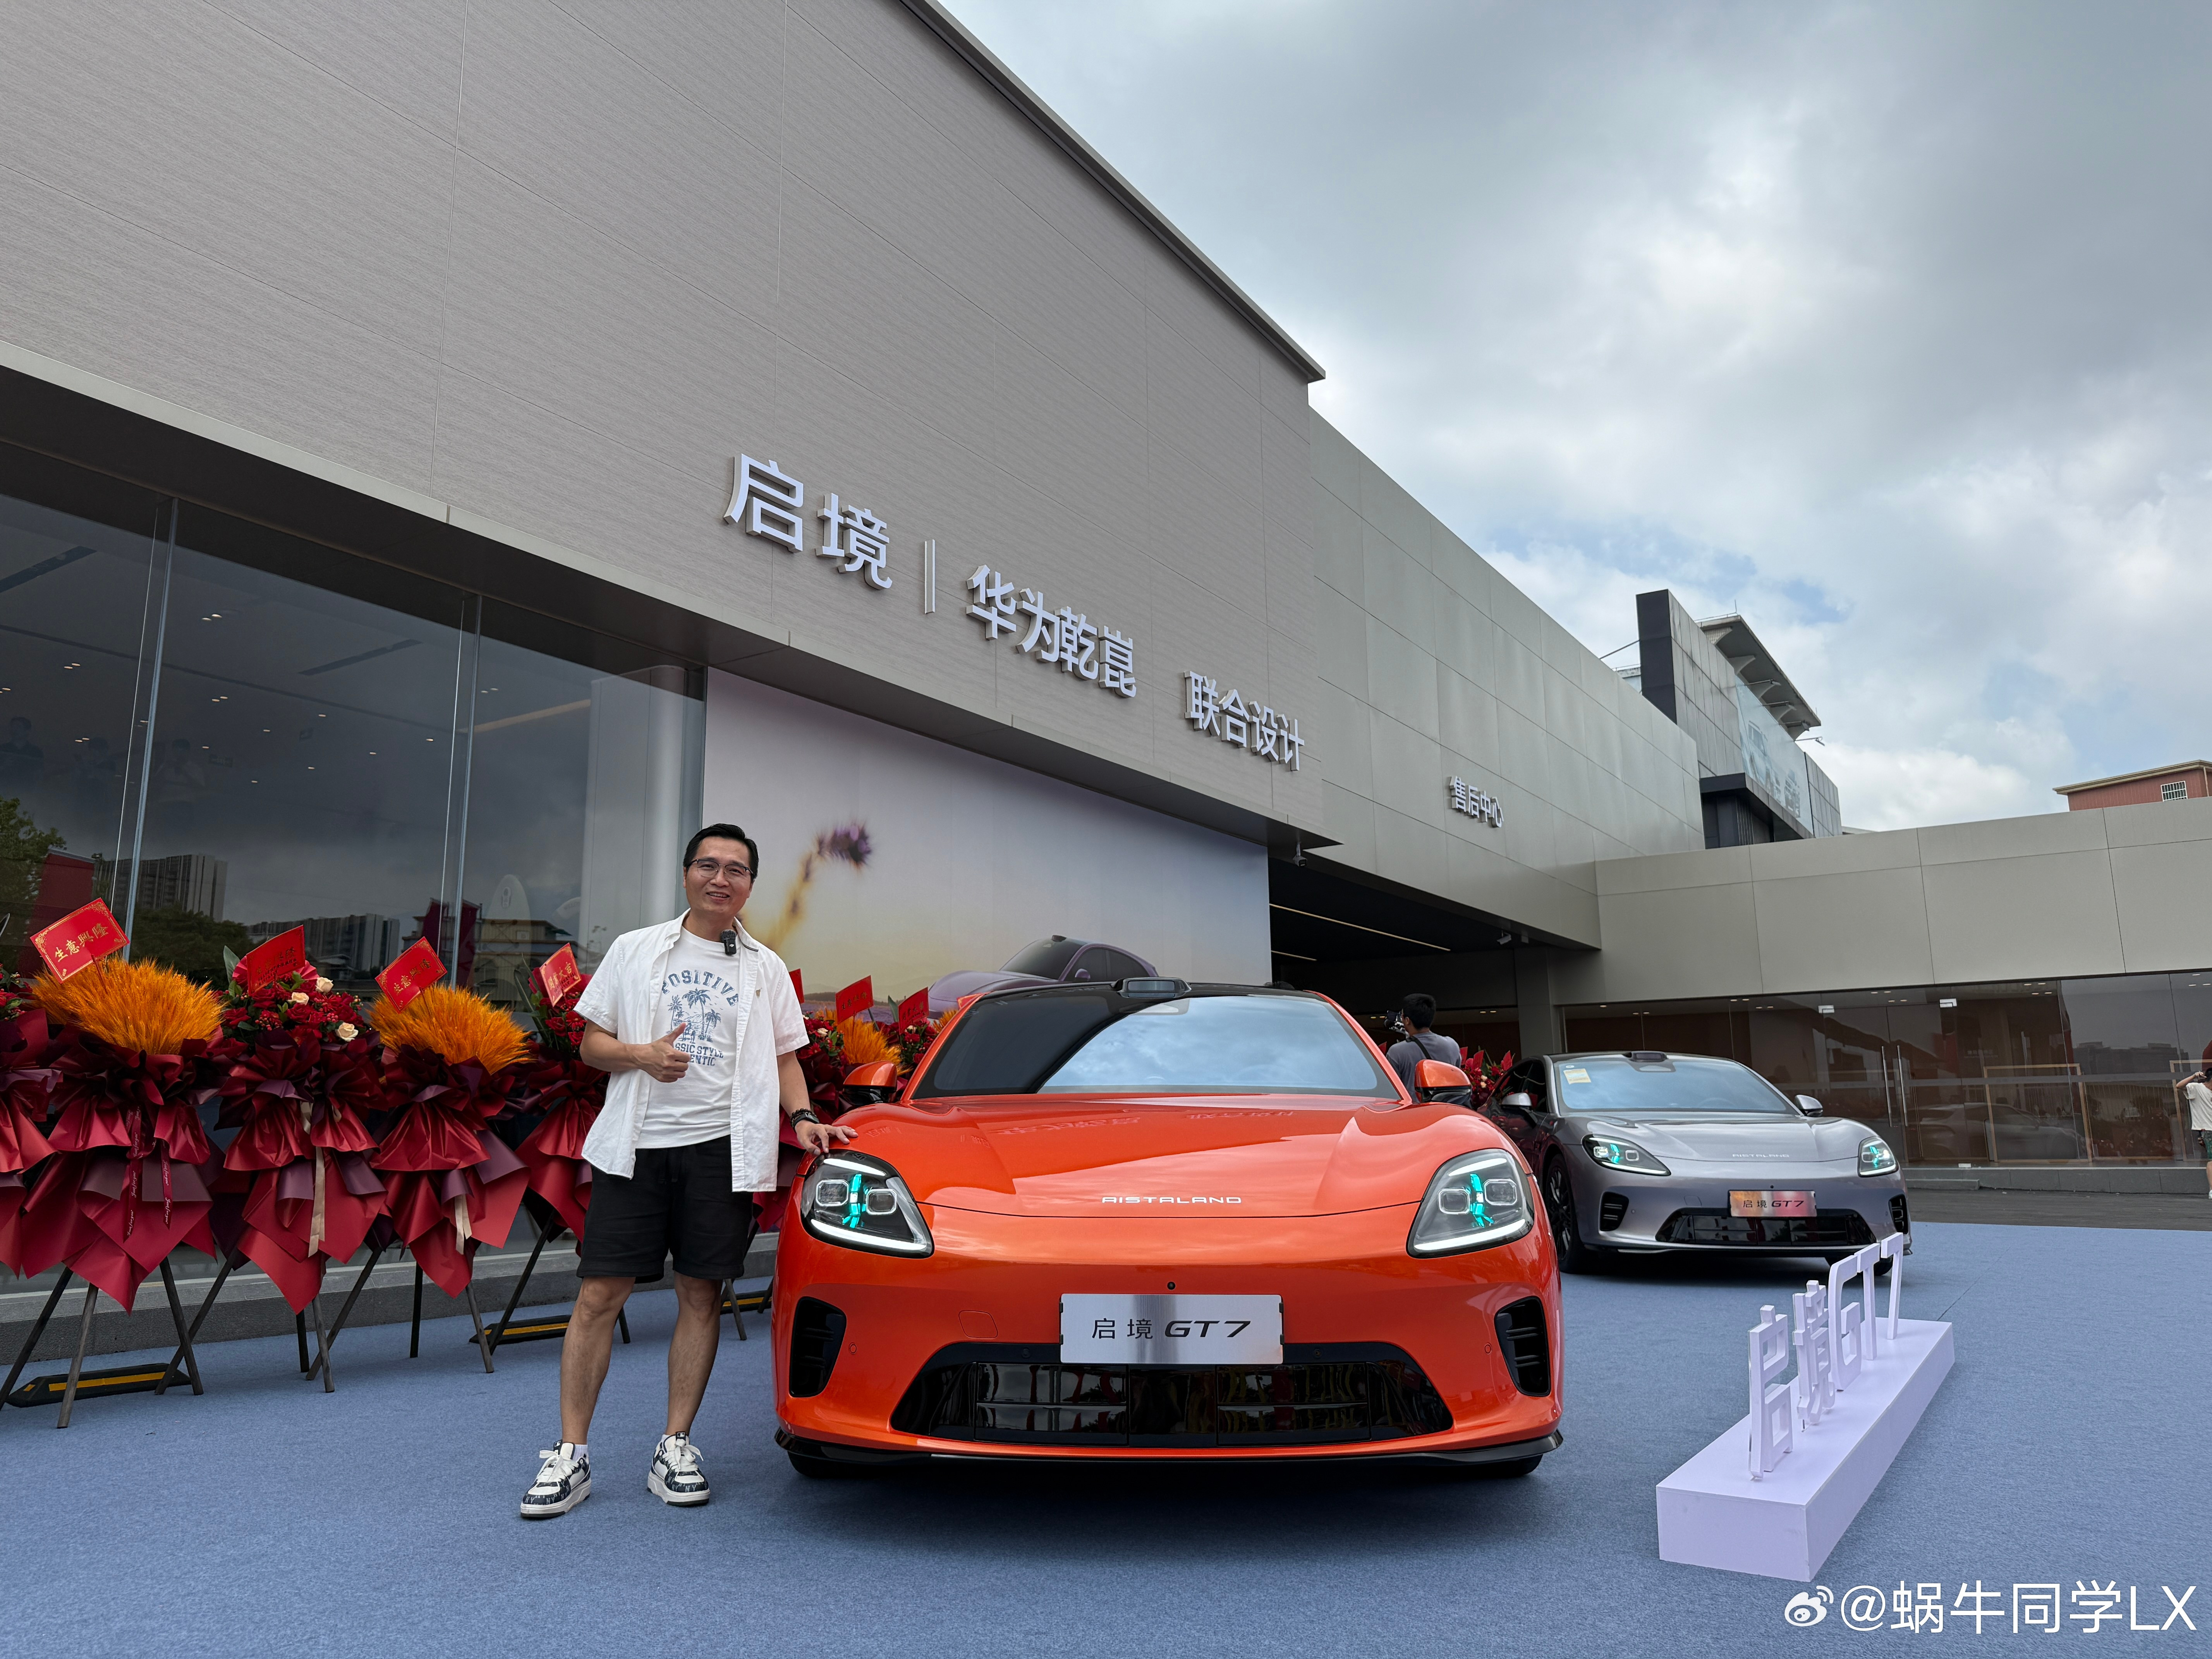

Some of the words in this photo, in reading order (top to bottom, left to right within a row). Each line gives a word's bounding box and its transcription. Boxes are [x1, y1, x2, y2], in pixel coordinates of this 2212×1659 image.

[724, 453, 892, 590] 启境
[966, 565, 1136, 697] 华为乾崑
[1184, 671, 1305, 771] 联合设计
[1450, 776, 1504, 828] 售后中心
[55, 923, 108, 962] 生意興隆
[675, 1043, 696, 1053] SSIC
[697, 1046, 723, 1058] STYLE
[690, 1054, 716, 1066] ENTIC
[1092, 1318, 1153, 1339] 启境
[1164, 1321, 1251, 1338] GT7
[1748, 1280, 1836, 1481] 启境
[1828, 1232, 1903, 1391] GT7
